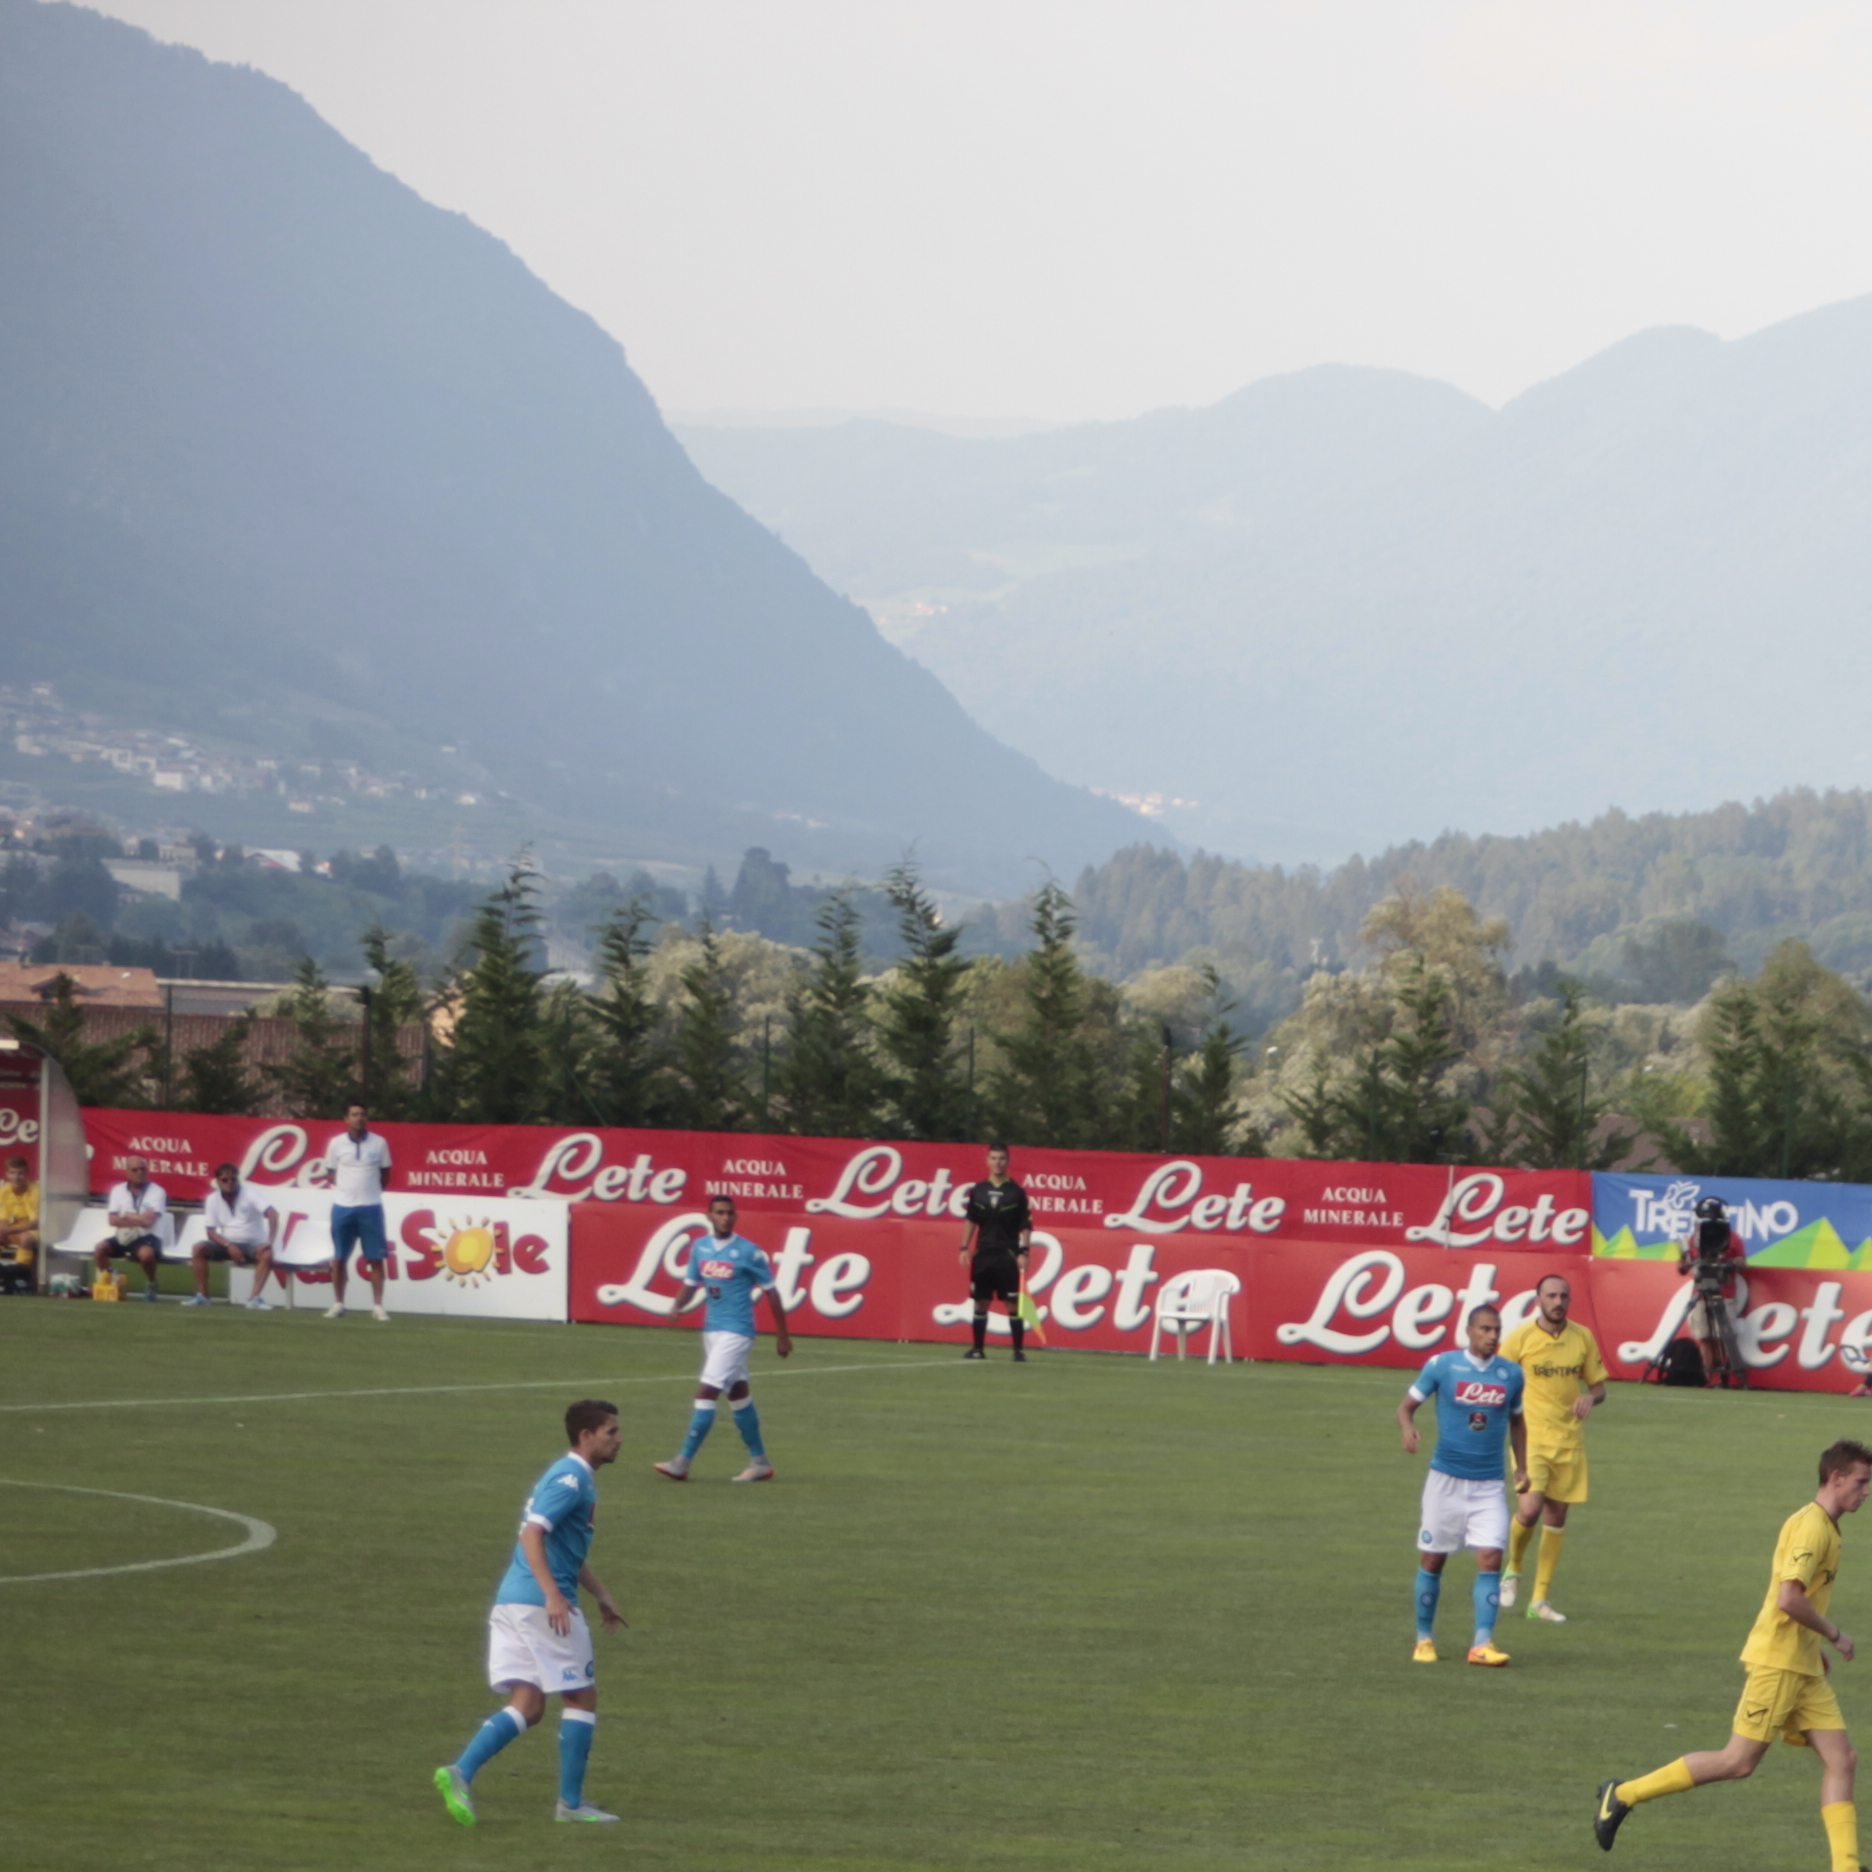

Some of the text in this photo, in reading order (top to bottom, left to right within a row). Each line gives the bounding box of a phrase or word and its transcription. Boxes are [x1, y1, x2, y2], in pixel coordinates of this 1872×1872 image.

[129, 1137, 192, 1153] ACQUA
[112, 1156, 208, 1176] MERALE
[426, 1149, 488, 1165] ACQUA
[507, 1133, 687, 1203] Lete
[723, 1159, 787, 1176] ACQUA
[408, 1171, 504, 1187] MINERALE
[1022, 1173, 1086, 1190] ACQUA
[705, 1180, 804, 1199] MINERALE
[1104, 1160, 1286, 1234] Lete
[1322, 1187, 1387, 1203] ACQUA
[1028, 1196, 1103, 1214] NERALE
[1405, 1173, 1590, 1247] Lete
[1303, 1209, 1404, 1227] MINERALE
[597, 1213, 871, 1318] Lte
[1456, 1382, 1506, 1404] Lete
